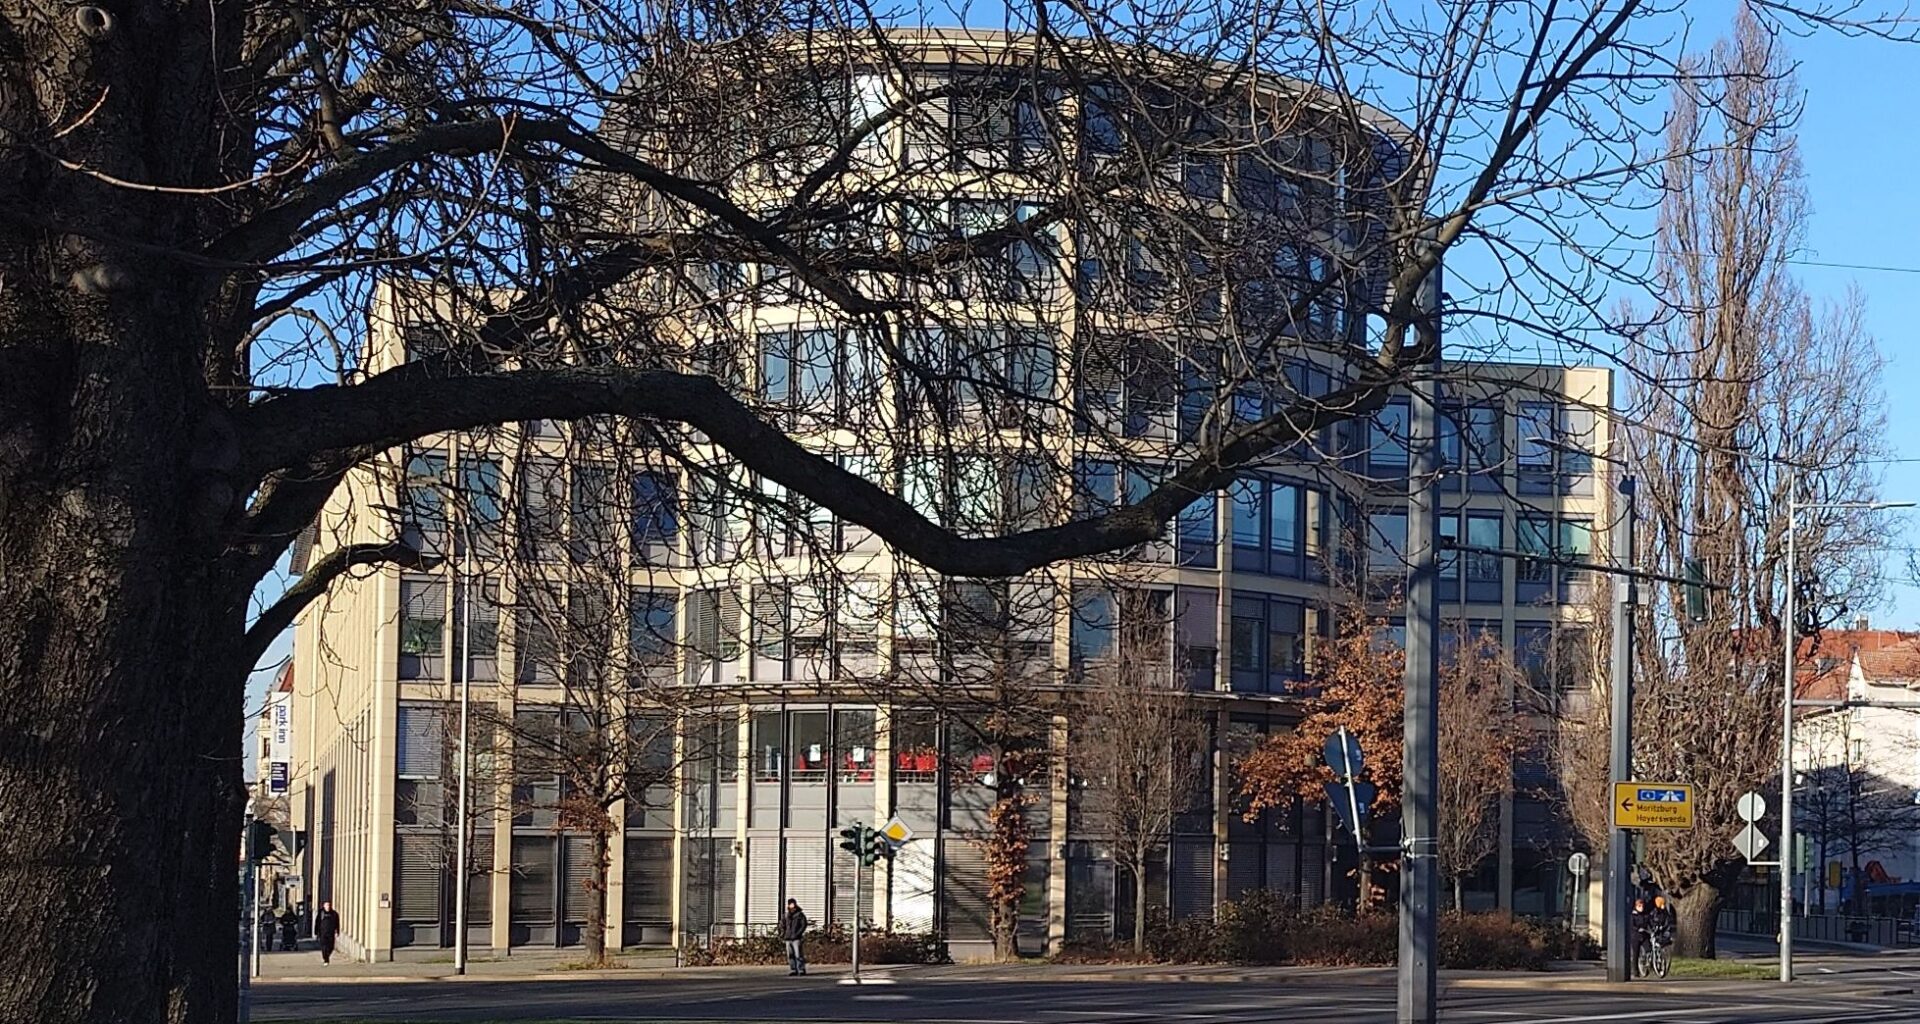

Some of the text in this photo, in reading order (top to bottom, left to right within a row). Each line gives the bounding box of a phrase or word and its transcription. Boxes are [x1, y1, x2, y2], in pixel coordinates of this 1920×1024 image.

[278, 705, 288, 744] park inn
[1636, 804, 1678, 814] Moritzburg
[1636, 814, 1686, 823] Hoyerswerda
